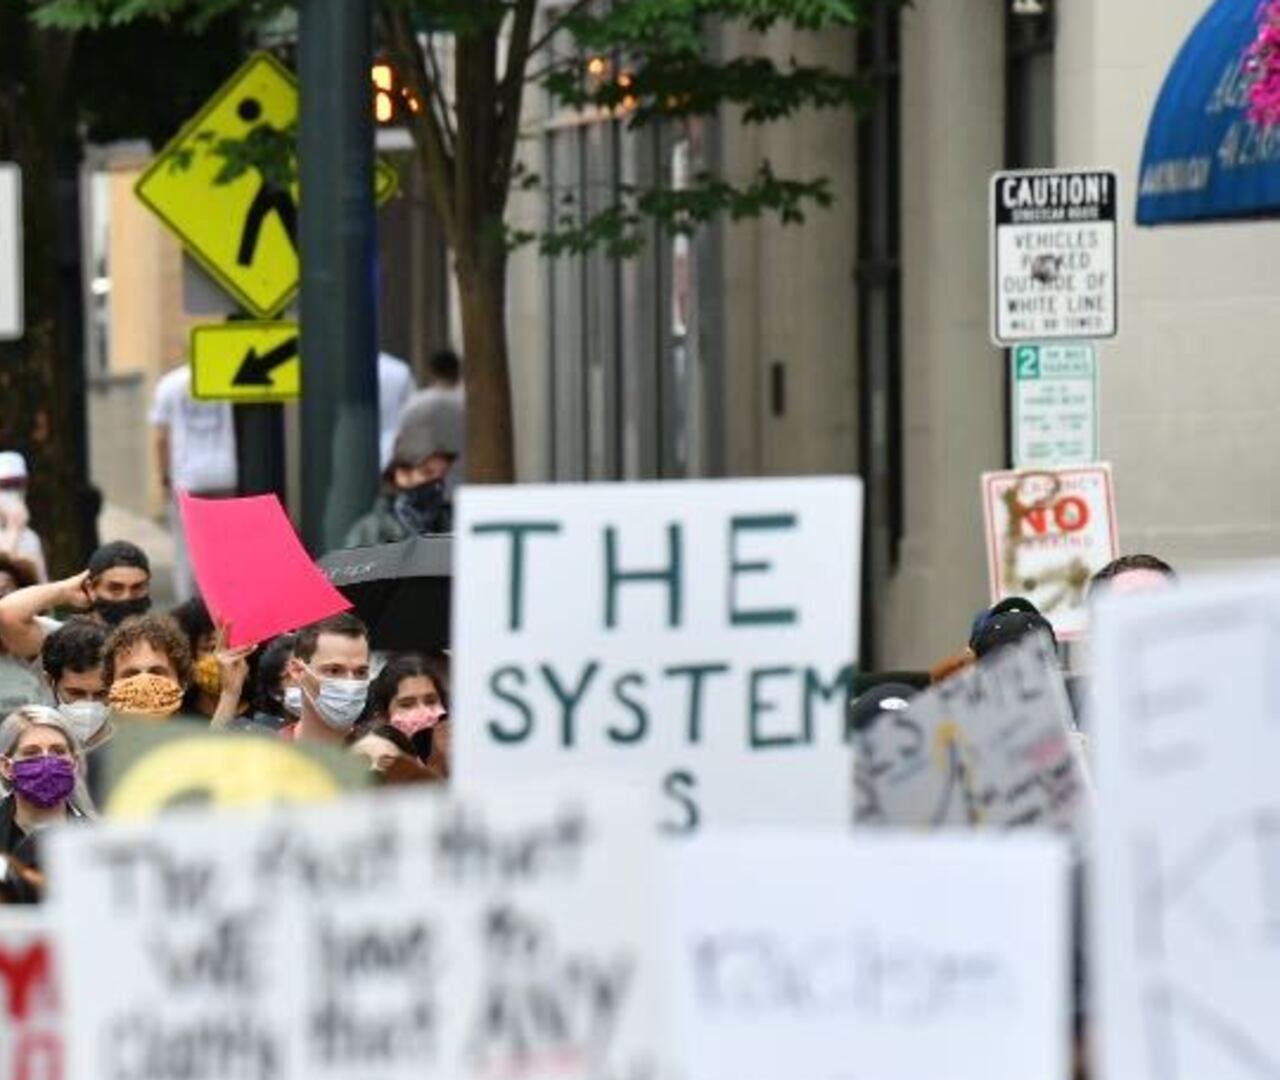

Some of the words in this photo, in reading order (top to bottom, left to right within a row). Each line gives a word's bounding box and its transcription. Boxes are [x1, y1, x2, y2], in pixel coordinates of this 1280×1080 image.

[1002, 174, 1109, 208] CAUTION!
[1014, 231, 1098, 249] VEHICLES
[1020, 347, 1037, 376] 2
[471, 513, 798, 632] THE
[487, 661, 858, 750] SYSTEM
